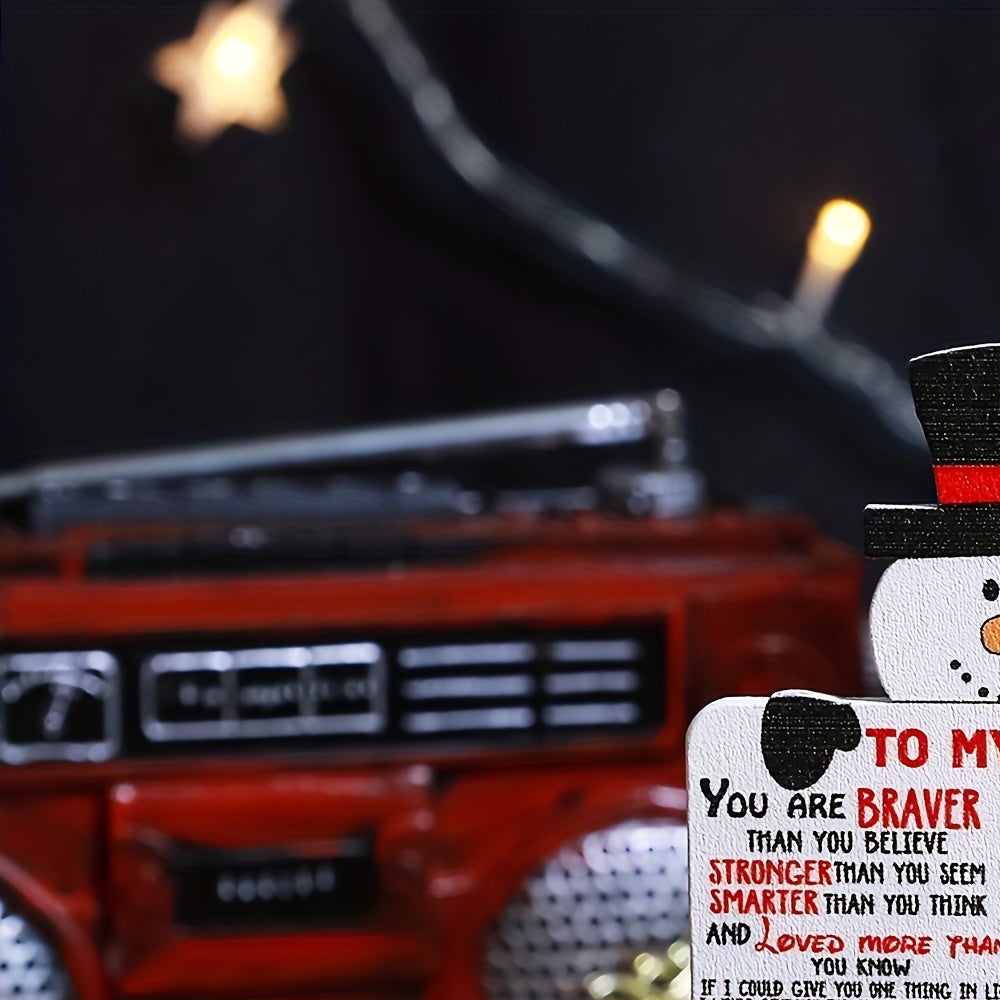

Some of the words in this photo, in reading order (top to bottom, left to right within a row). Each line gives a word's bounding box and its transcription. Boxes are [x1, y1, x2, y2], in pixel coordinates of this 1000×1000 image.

[866, 728, 928, 768] TO
[747, 829, 802, 853] THAN
[813, 831, 853, 854] YOU
[864, 831, 948, 855] BELIEVE
[709, 859, 835, 885] STRONGER
[834, 861, 884, 884] THAN
[893, 861, 929, 885] YOU
[940, 863, 985, 885] SEEM
[710, 889, 818, 917] SMARTER
[823, 893, 875, 916] THAN
[883, 894, 920, 915] YOU
[929, 893, 987, 916] THINK
[706, 922, 751, 946] AND
[811, 958, 847, 976] YOU
[856, 957, 910, 977] KNOW
[700, 979, 716, 999] IF
[722, 979, 733, 1000] I
[737, 980, 786, 1000] COULD
[790, 981, 829, 1000] GIVE
[833, 981, 863, 1000] YOU
[868, 981, 899, 1000] ONE
